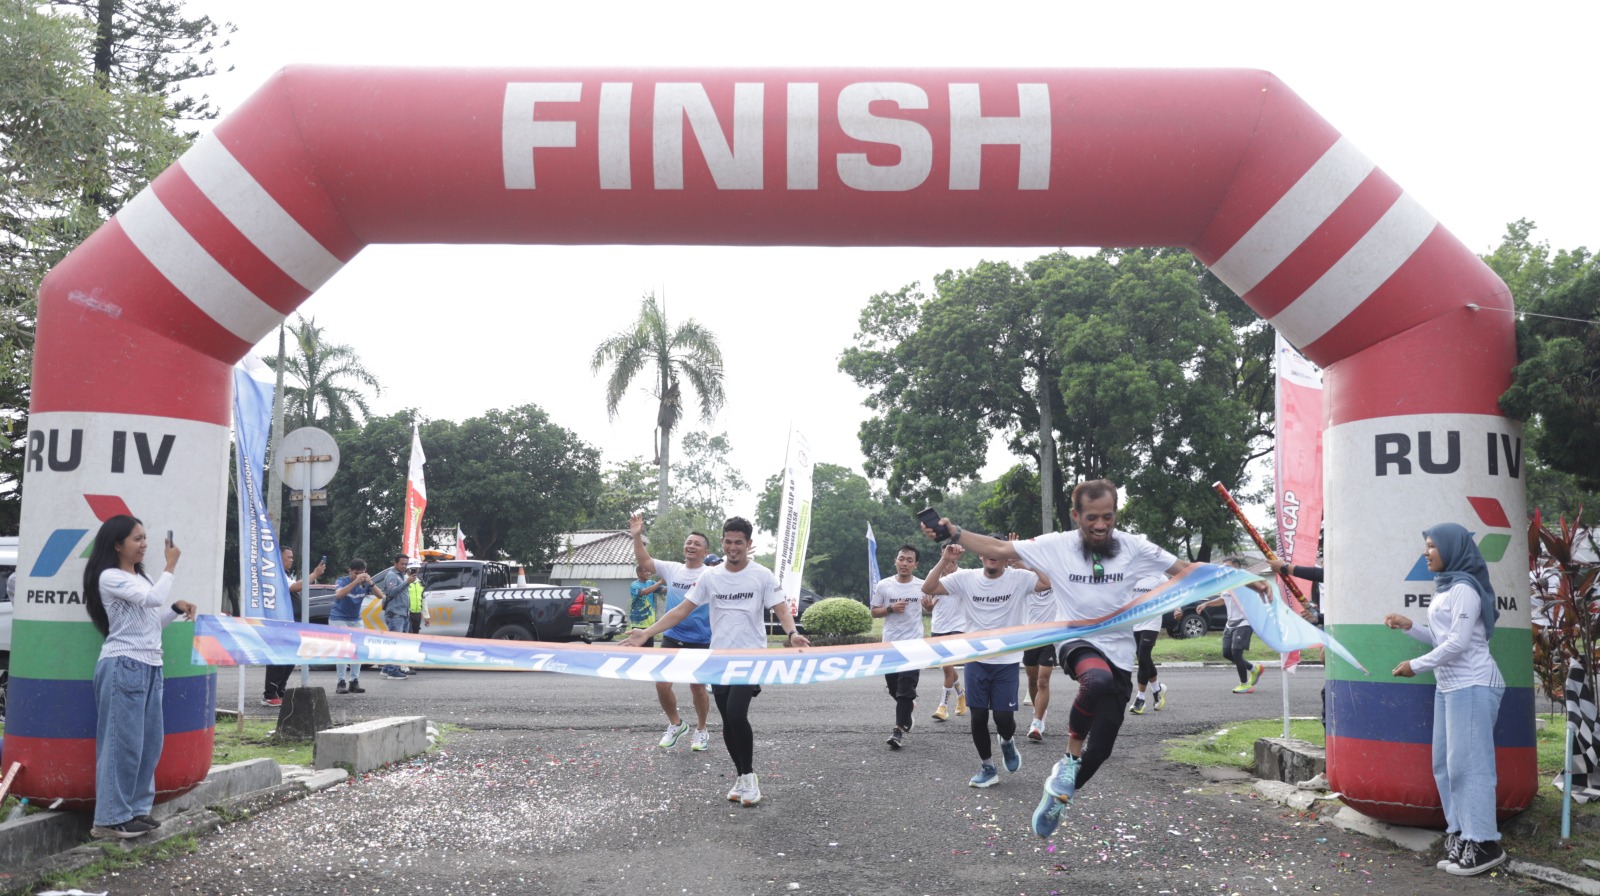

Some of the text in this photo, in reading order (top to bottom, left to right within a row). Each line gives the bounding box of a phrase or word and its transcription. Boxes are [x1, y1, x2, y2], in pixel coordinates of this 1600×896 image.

[501, 82, 1051, 191] FINISH
[27, 429, 176, 476] RU IV
[1375, 431, 1521, 479] RU IV
[250, 519, 258, 564] PERTAMINA
[1282, 490, 1300, 563] ILACAP
[251, 565, 259, 597] KILANG
[261, 557, 276, 578] IV
[251, 598, 259, 608] PT
[262, 583, 276, 609] RU
[720, 654, 884, 685] FINISH
